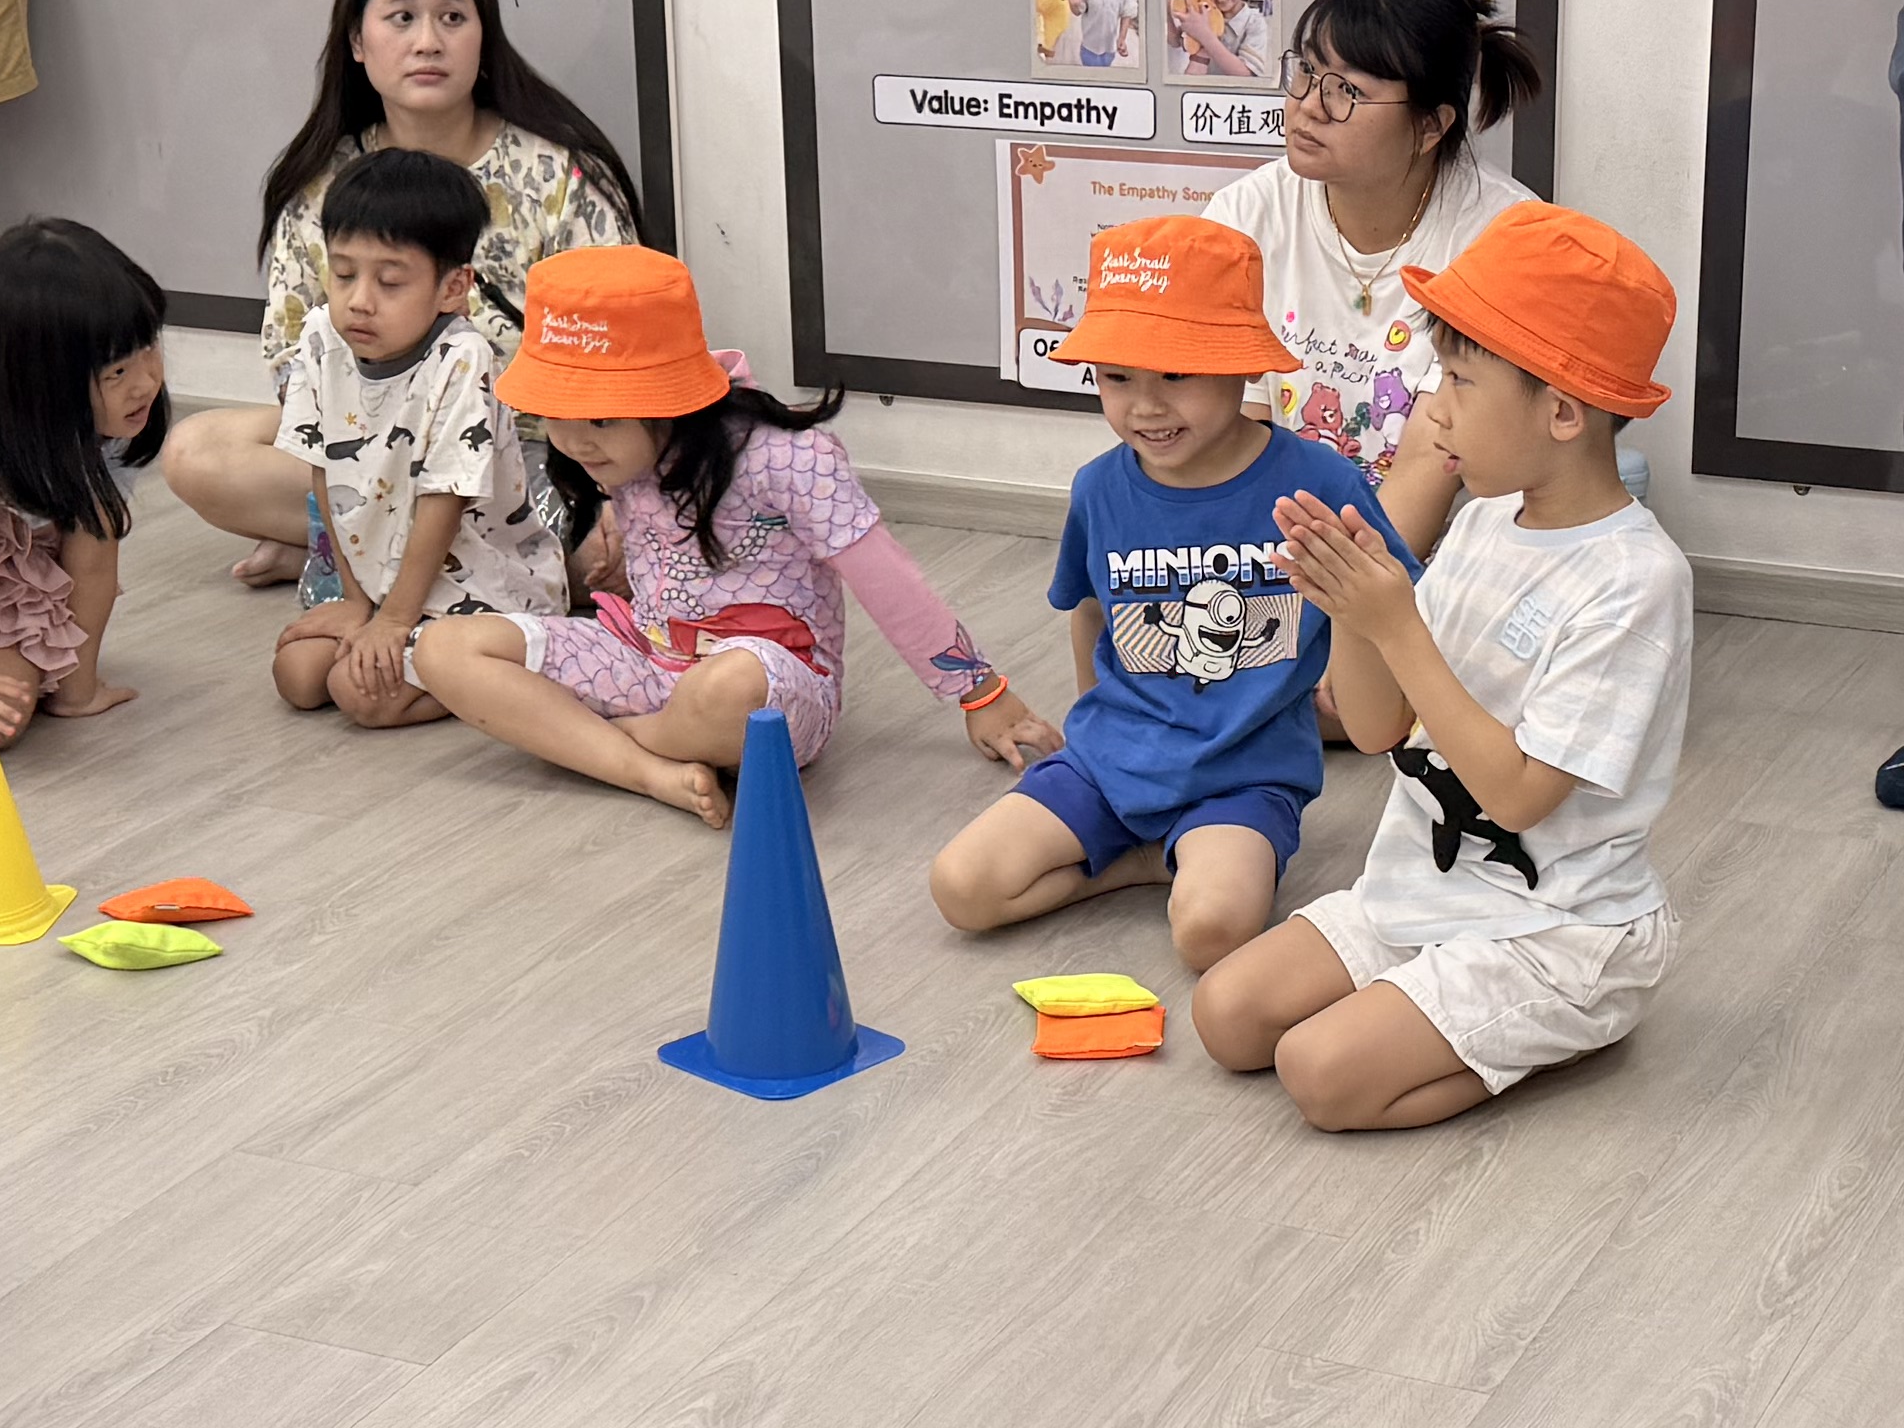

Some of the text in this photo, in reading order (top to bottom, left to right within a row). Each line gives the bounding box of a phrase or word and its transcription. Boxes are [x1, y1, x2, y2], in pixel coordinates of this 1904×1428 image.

[909, 88, 1118, 131] Value: Empathy
[1091, 181, 1114, 197] The
[1119, 183, 1178, 203] Empathy
